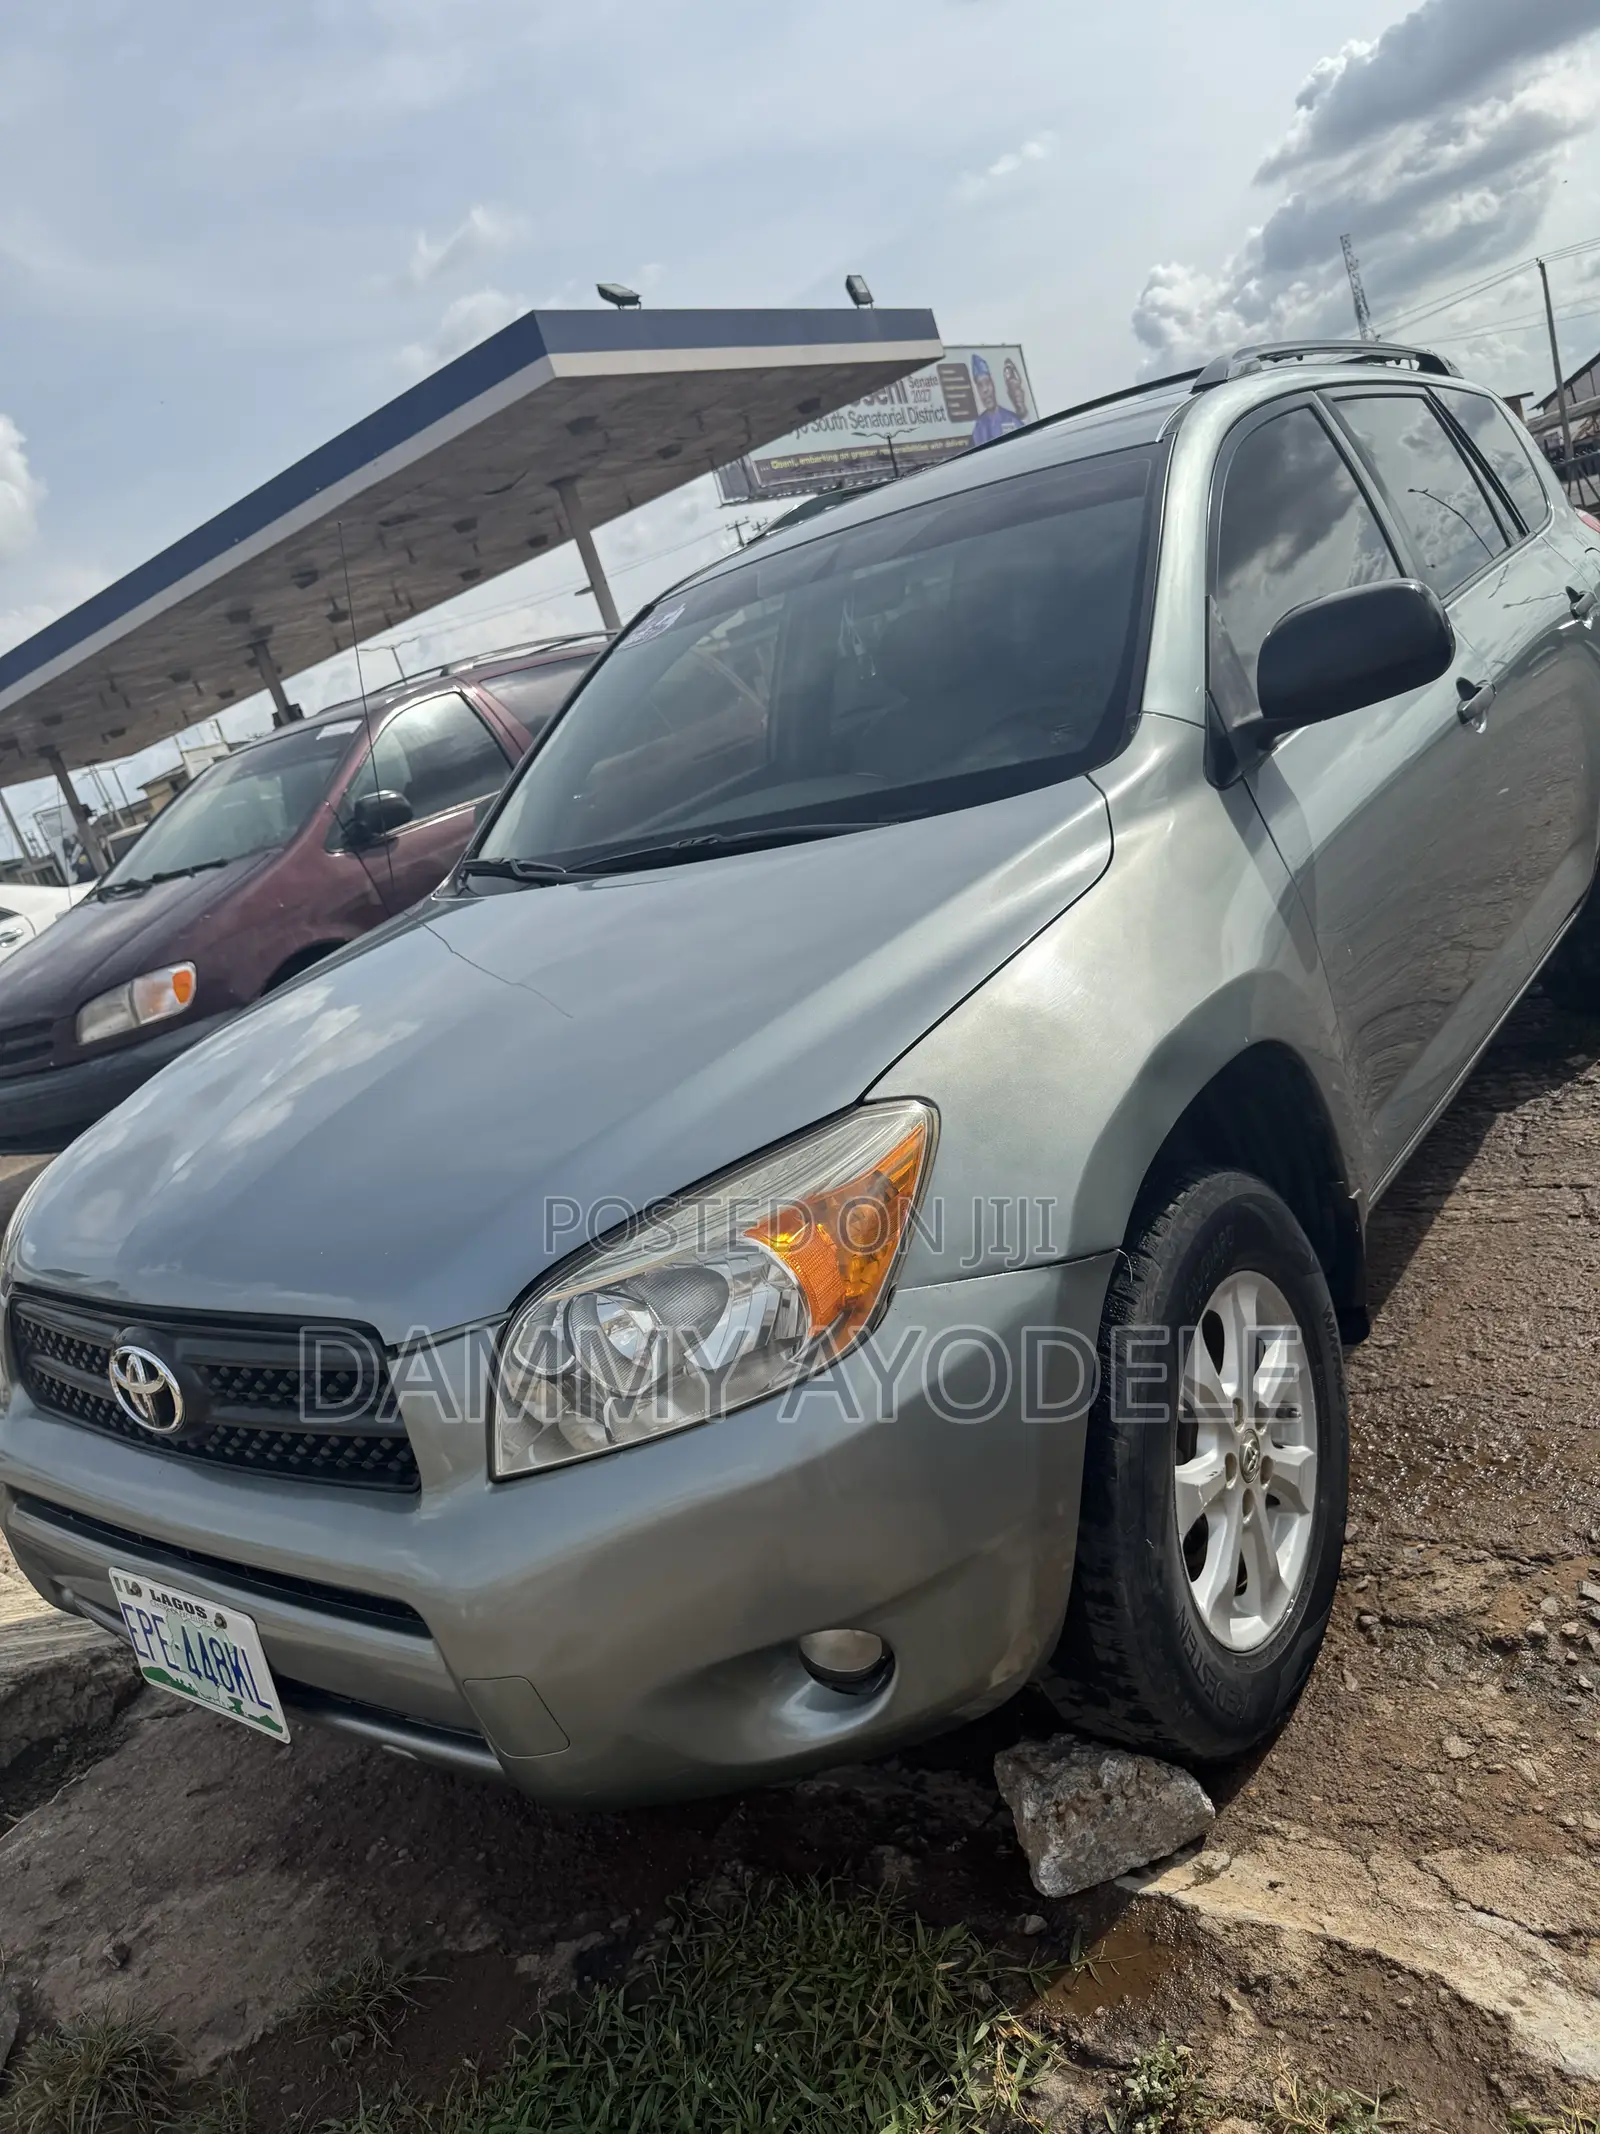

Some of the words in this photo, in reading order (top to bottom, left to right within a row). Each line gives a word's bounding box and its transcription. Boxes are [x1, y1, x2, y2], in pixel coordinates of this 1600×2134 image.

[908, 374, 939, 388] Senate
[910, 388, 932, 403] 2027
[811, 412, 848, 433] South
[848, 402, 906, 429] Senatorial
[907, 401, 947, 426] District
[149, 1588, 208, 1620] LAGOS
